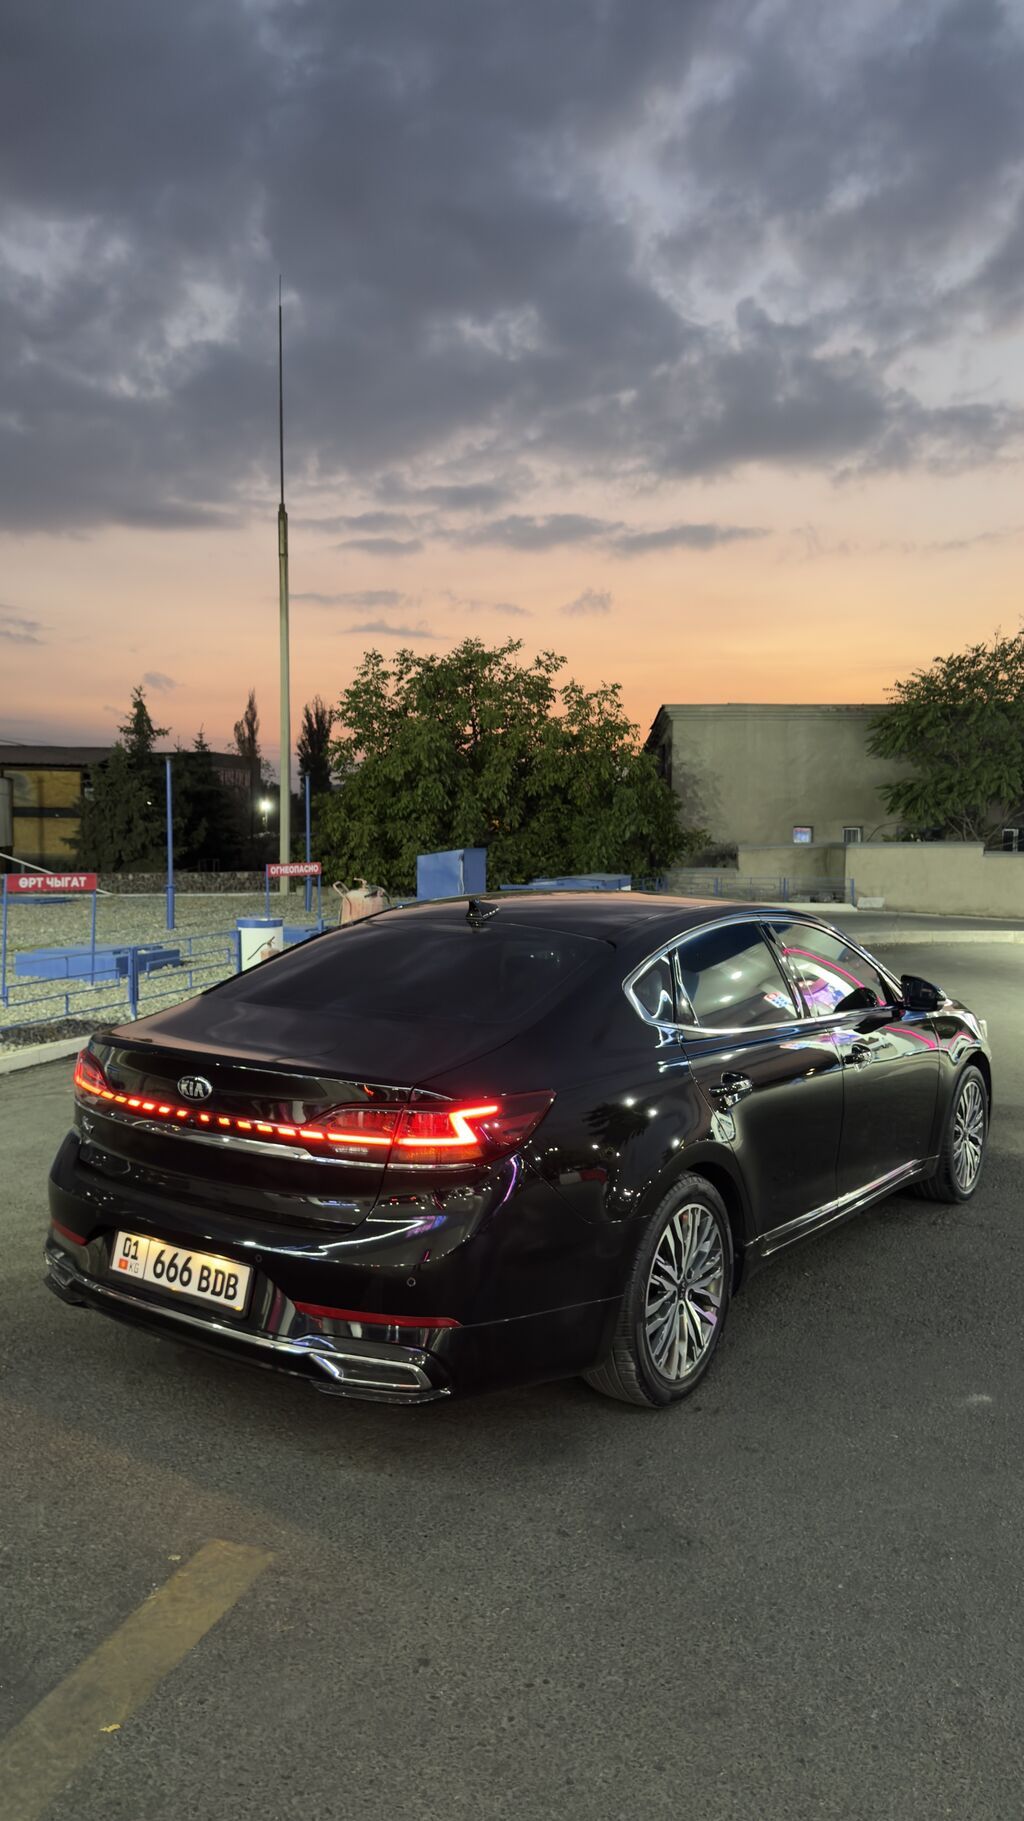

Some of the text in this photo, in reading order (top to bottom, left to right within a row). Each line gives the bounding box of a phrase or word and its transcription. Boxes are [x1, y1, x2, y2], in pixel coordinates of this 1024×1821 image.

[270, 864, 319, 875] ОГНЕОПАСНО
[18, 876, 87, 888] ӨРТ ЧЫГАТ
[180, 1080, 205, 1097] KIA
[122, 1237, 239, 1301] 01 666 BDB
[128, 1261, 140, 1274] KG
